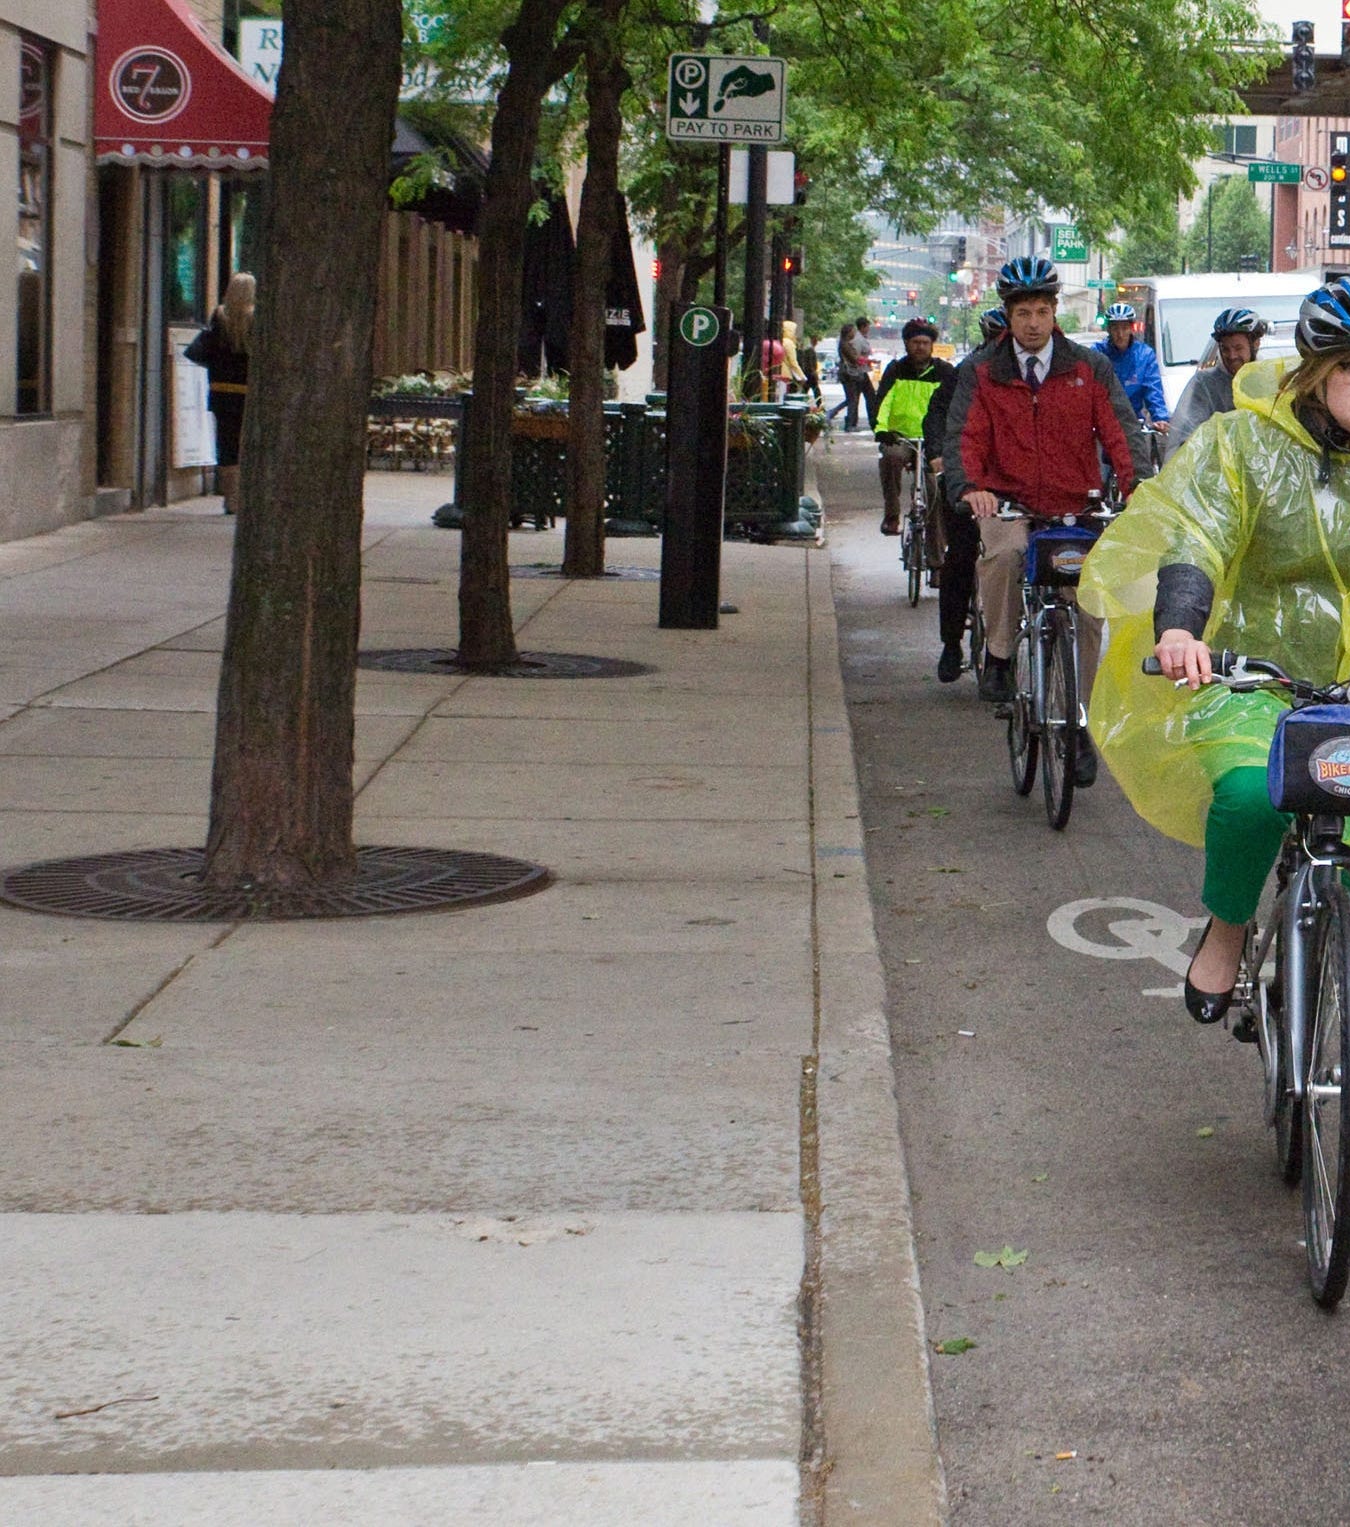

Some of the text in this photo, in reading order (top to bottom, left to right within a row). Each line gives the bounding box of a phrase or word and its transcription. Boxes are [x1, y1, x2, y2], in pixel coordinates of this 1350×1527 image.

[684, 63, 700, 83] P
[676, 121, 773, 137] PAY TO PARK
[1258, 165, 1288, 174] WELLS
[692, 313, 710, 339] P
[1319, 763, 1346, 778] BIKE
